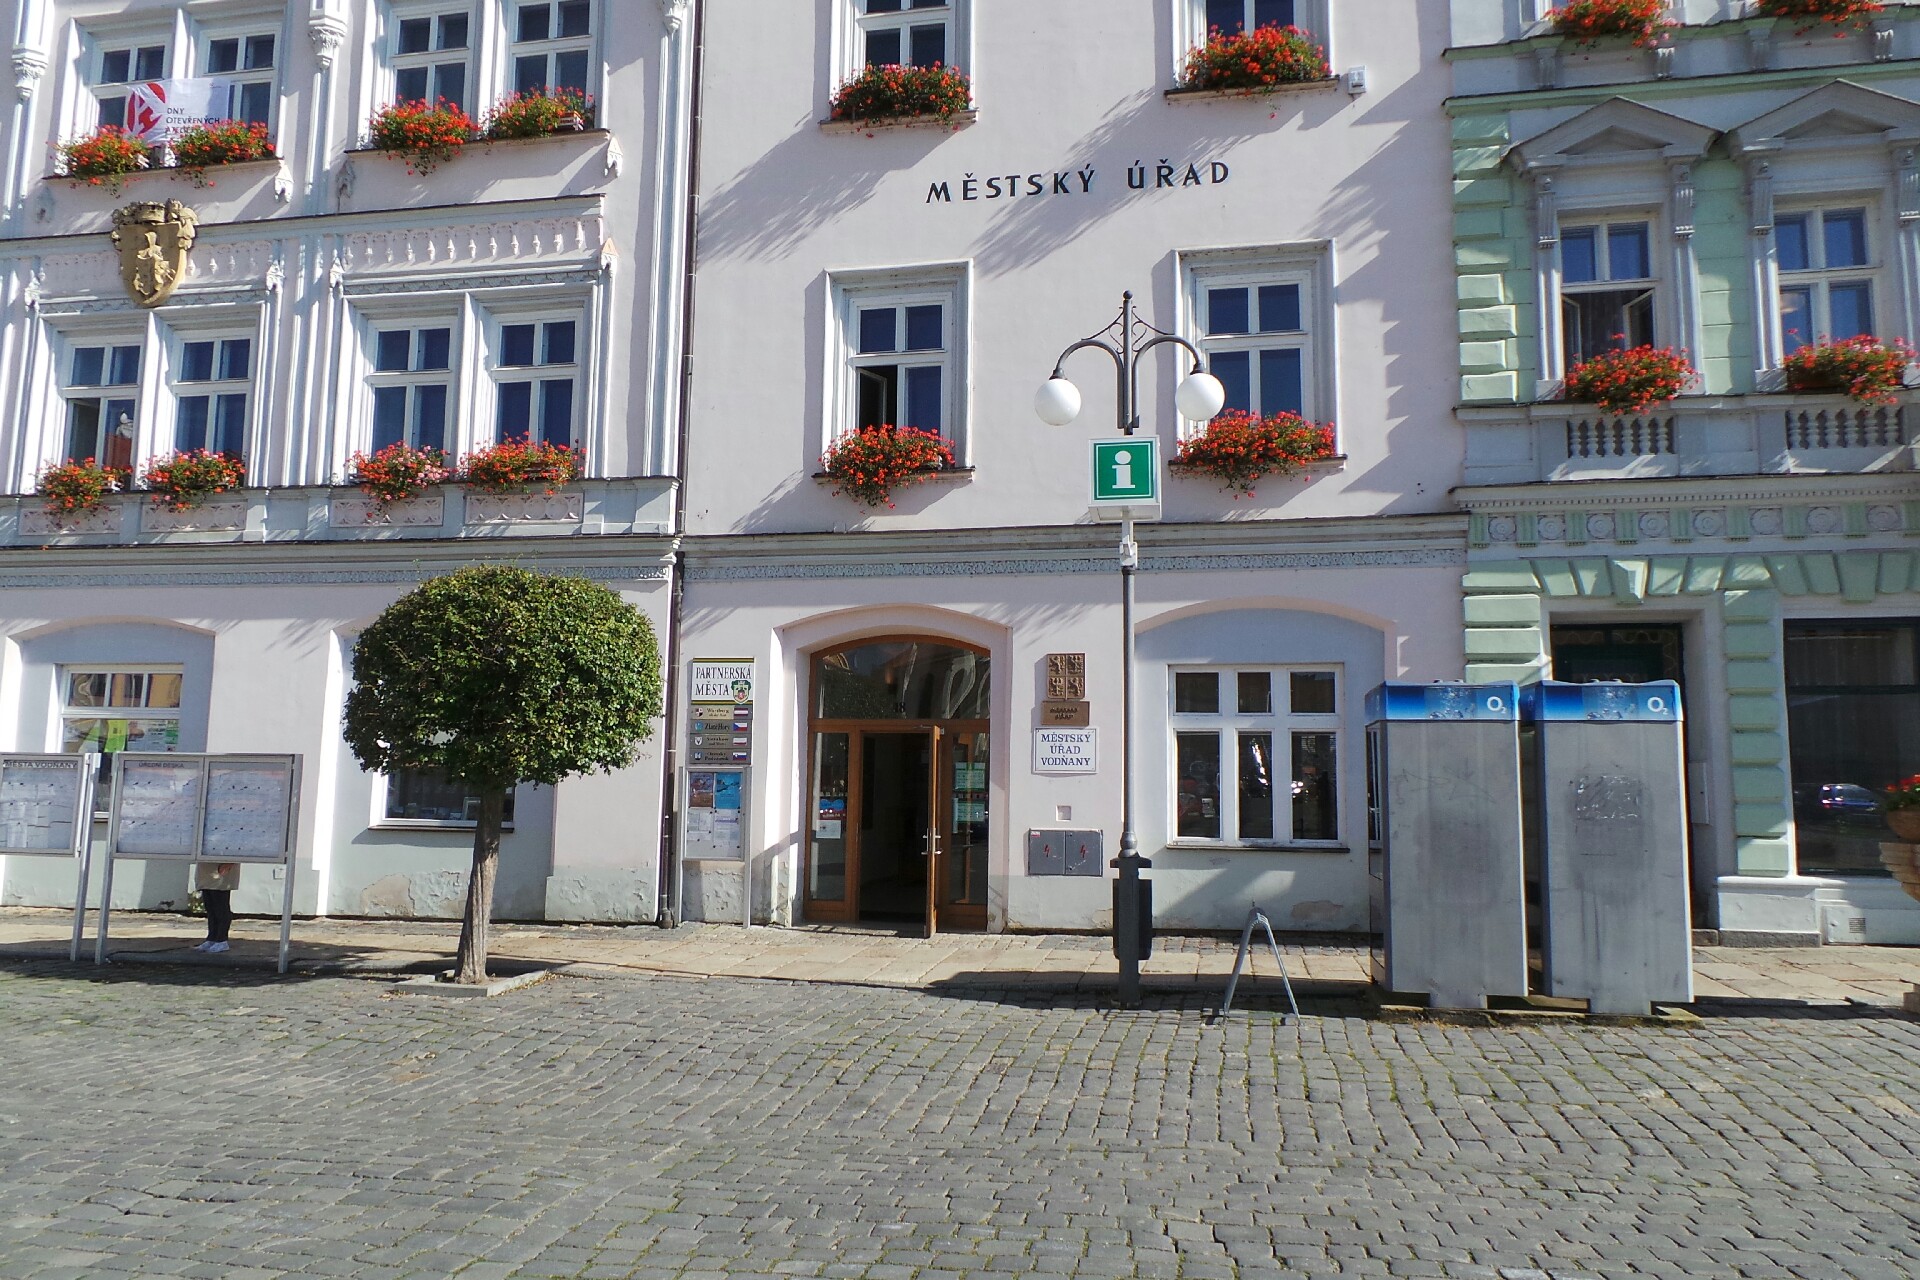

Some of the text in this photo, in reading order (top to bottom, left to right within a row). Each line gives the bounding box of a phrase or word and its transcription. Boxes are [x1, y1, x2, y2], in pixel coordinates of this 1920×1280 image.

[167, 107, 185, 115] DNY
[166, 115, 220, 125] OTEVŘENÝCH
[925, 159, 1230, 204] MĚSTSKÝ ÚŘAD
[1111, 450, 1136, 489] i
[695, 664, 752, 680] PARTNERSKÁ
[695, 680, 730, 696] MĚSTA
[1486, 695, 1507, 714] O2
[1647, 696, 1669, 715] O2
[1040, 731, 1091, 743] MĚSTSKÝ
[1050, 743, 1081, 754] ÚŘAD
[1040, 754, 1091, 766] VODŇANY
